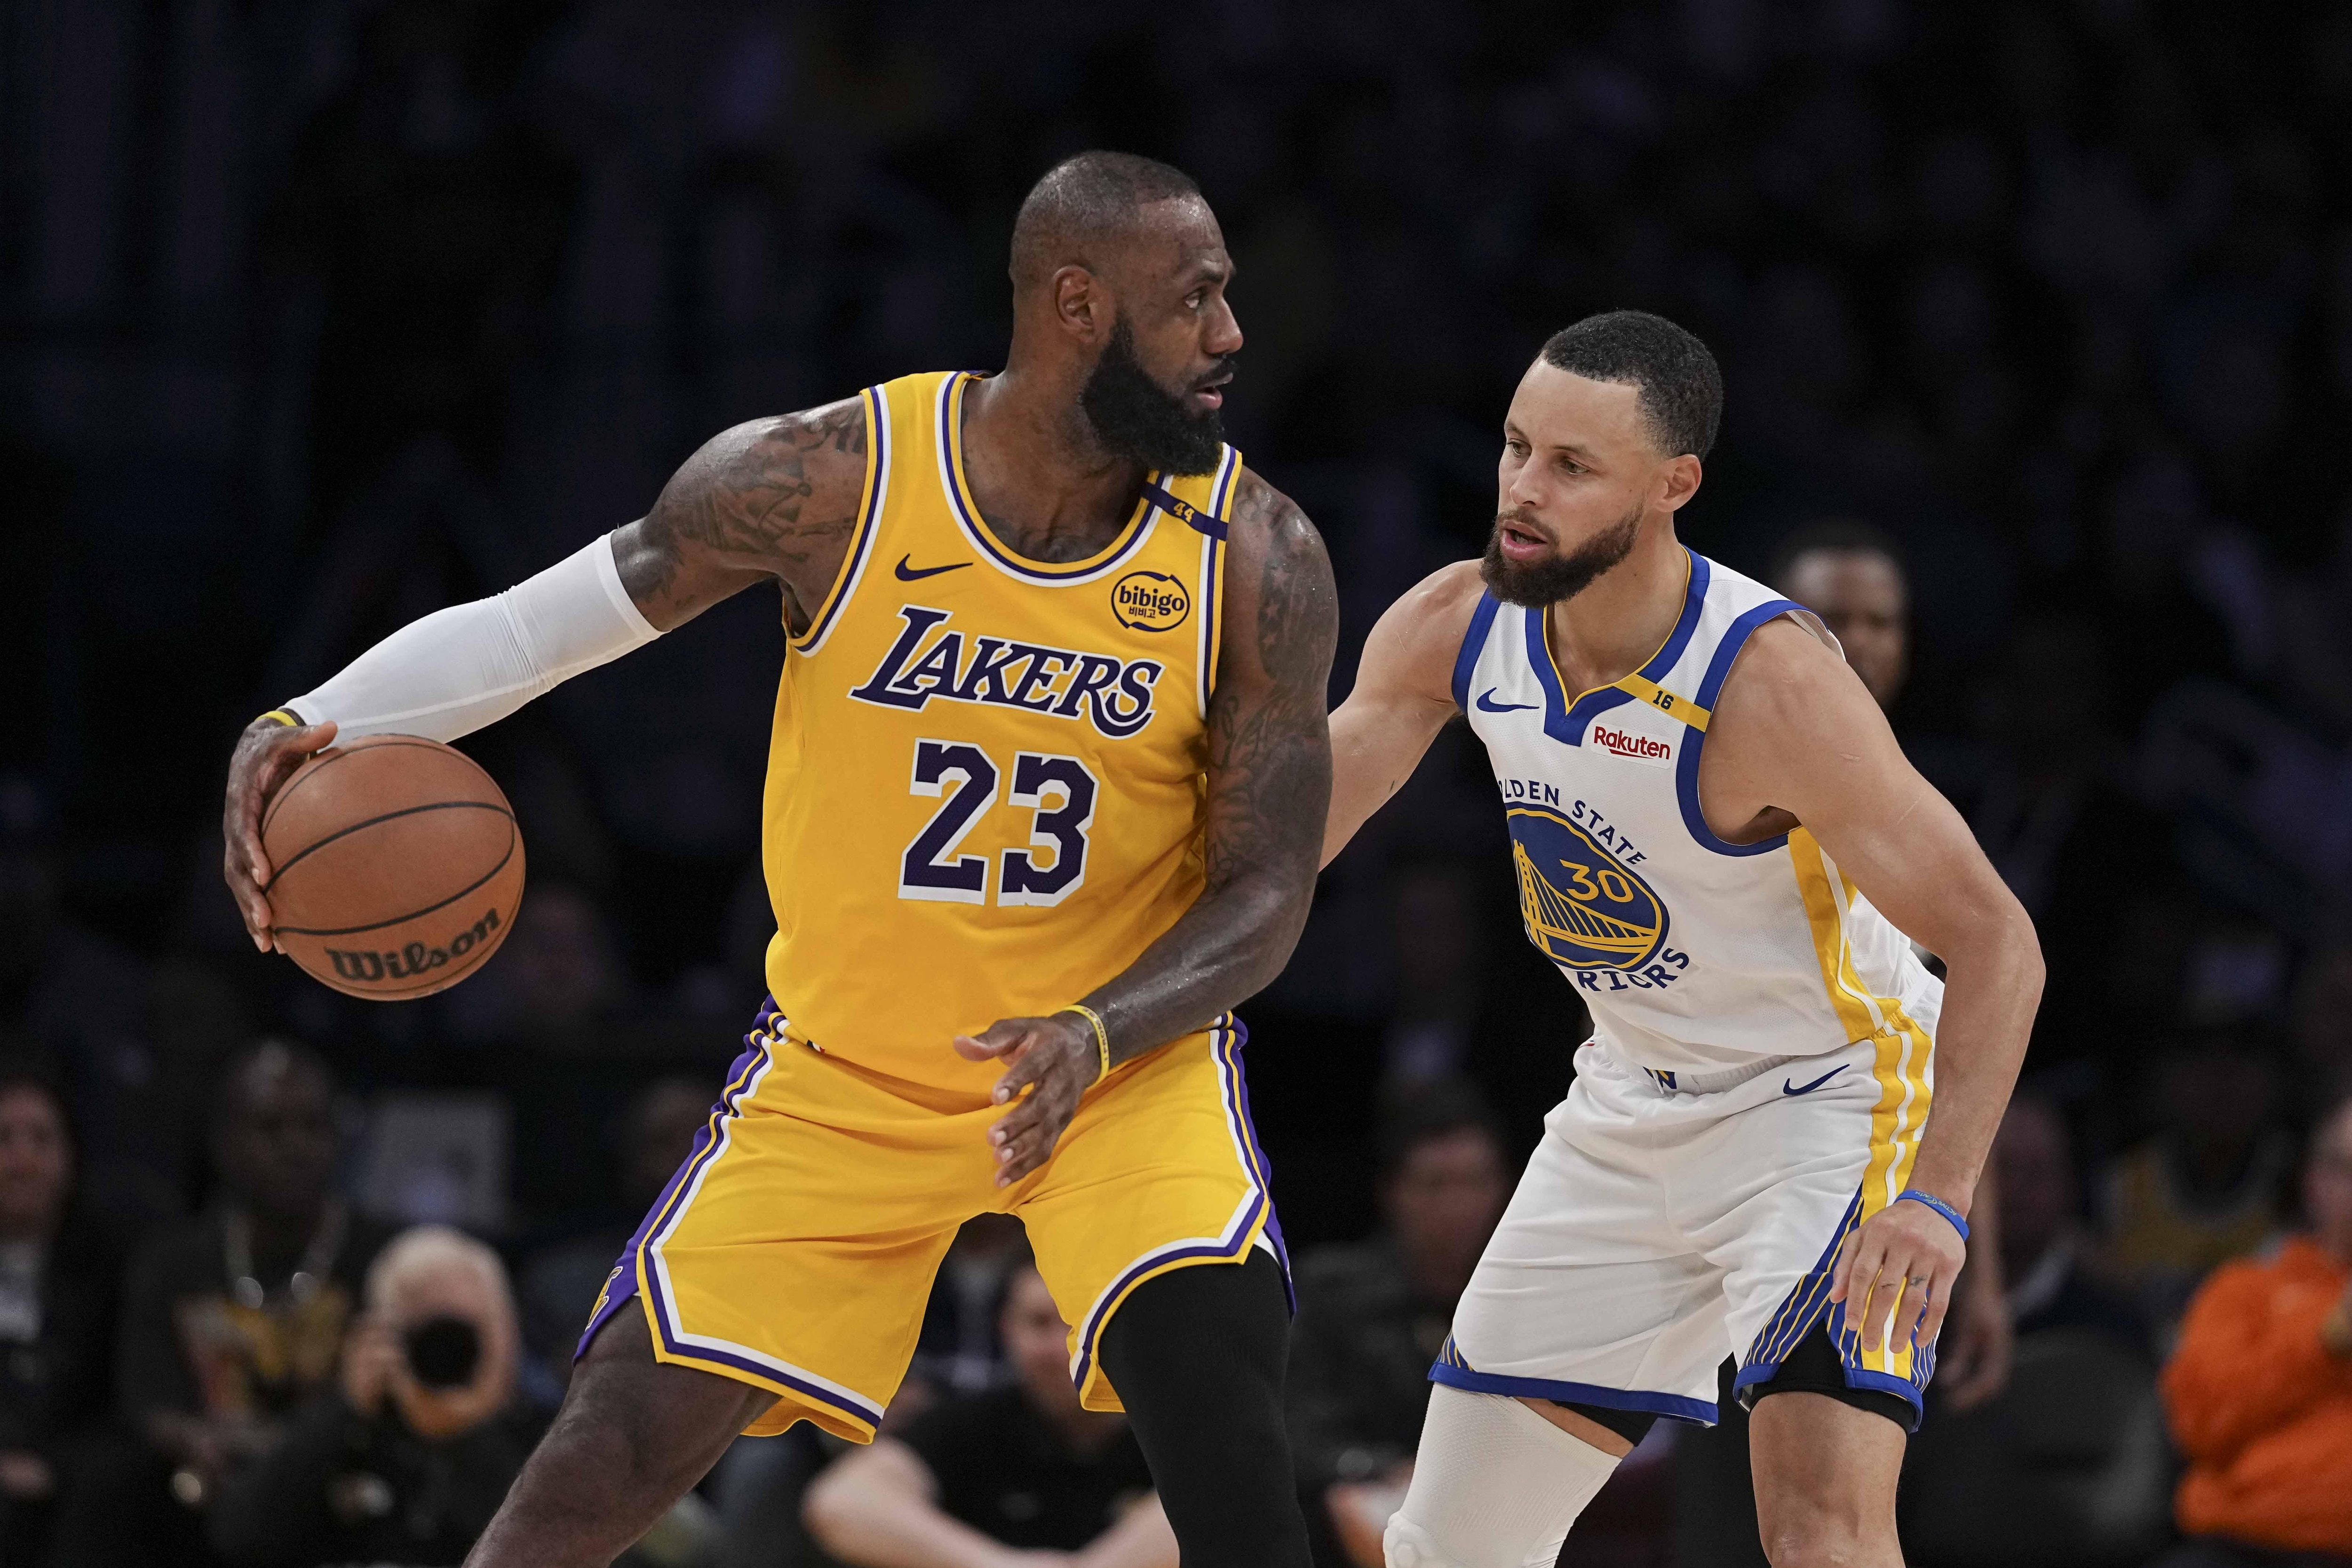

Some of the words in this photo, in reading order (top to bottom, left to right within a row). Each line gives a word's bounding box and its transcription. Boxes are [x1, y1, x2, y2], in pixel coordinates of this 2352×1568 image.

[1173, 502, 1195, 523] 44
[1119, 585, 1185, 616] bibigo
[1128, 606, 1156, 619] 비비고
[847, 603, 1166, 739] LAKERS
[1653, 690, 1674, 710] 16
[1594, 726, 1670, 760] Rakuten
[898, 737, 1099, 907] 23
[1572, 800, 1648, 865] STATE
[1559, 859, 1634, 903] 30
[324, 907, 501, 982] Wilson
[1938, 1201, 1957, 1215] ACTIVE
